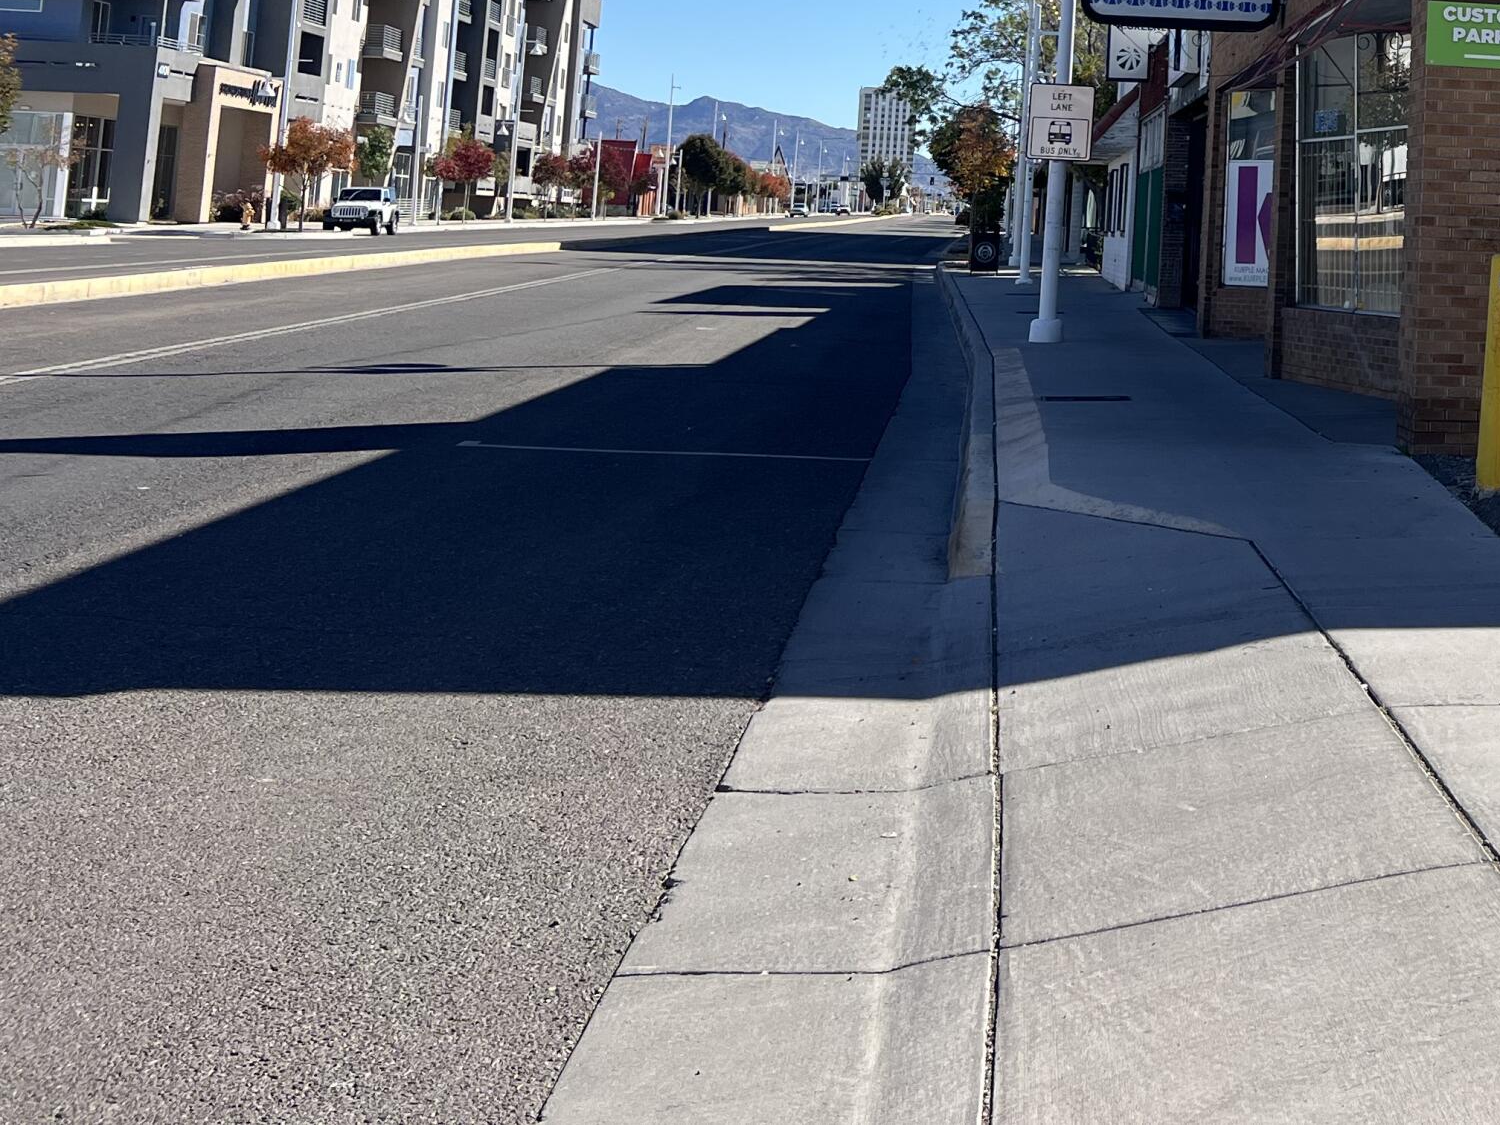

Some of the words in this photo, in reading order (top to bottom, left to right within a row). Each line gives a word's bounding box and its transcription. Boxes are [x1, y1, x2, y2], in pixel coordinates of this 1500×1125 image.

[1052, 92, 1073, 101] LEFT
[1050, 103, 1073, 112] LANE
[1040, 146, 1055, 154] BUS
[1058, 147, 1078, 155] ONLY
